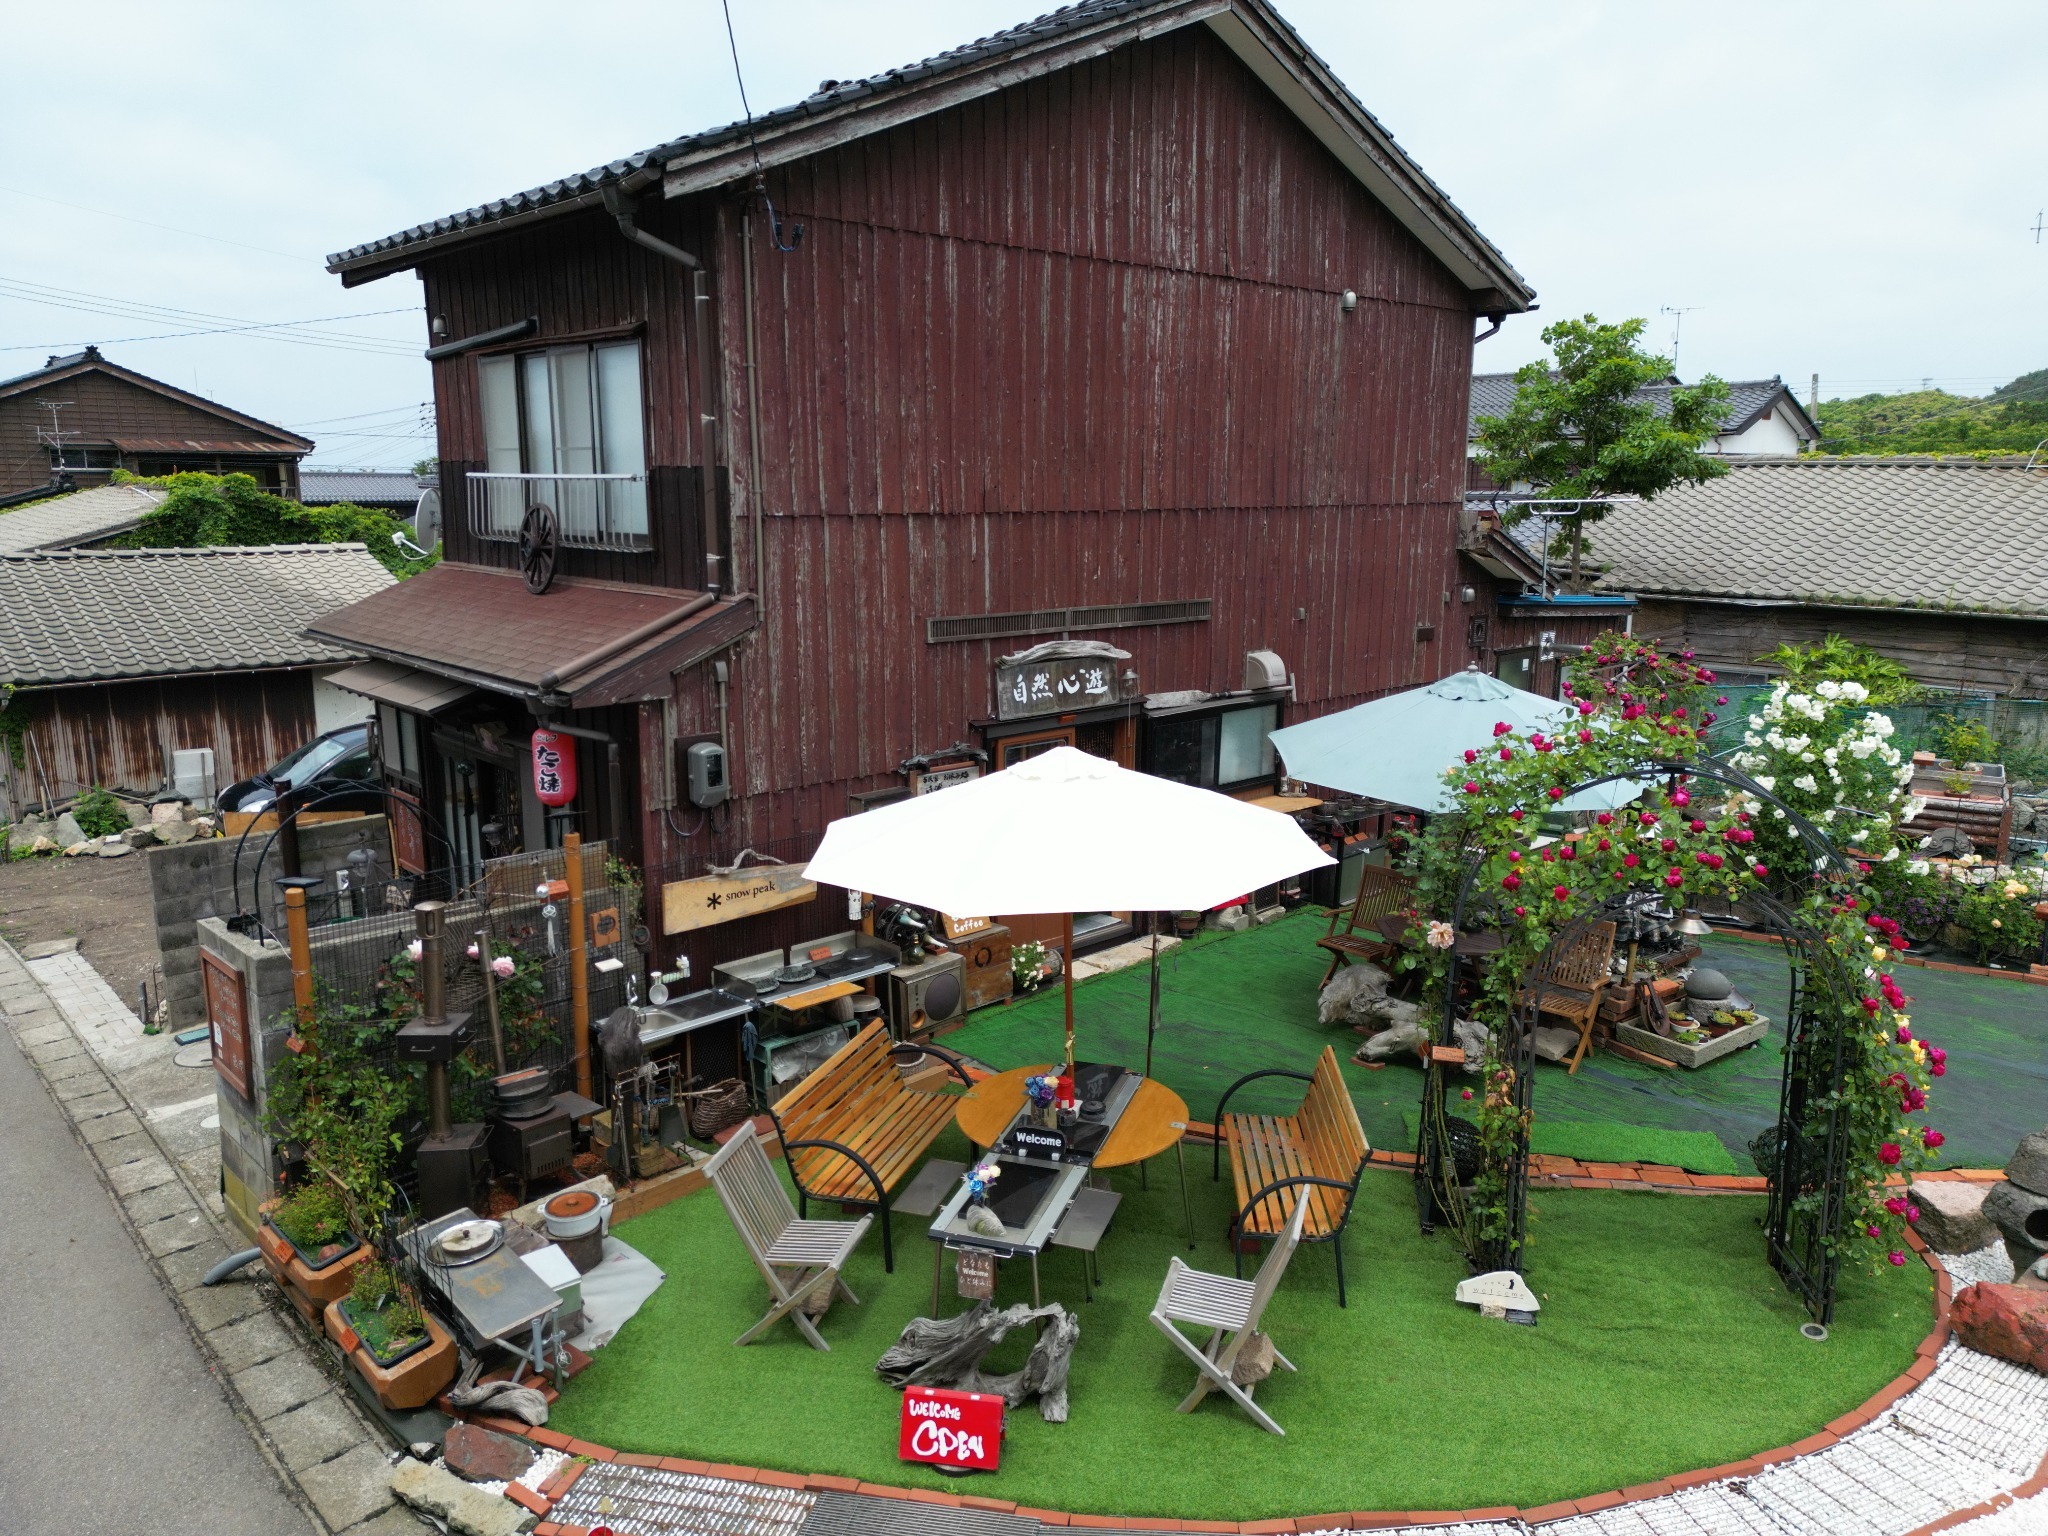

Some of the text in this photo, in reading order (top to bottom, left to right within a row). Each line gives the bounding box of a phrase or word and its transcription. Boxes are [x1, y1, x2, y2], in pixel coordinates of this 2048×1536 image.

[1013, 667, 1108, 704] 自然心遊
[537, 745, 561, 793] たこ焼
[725, 881, 776, 901] snow peak
[953, 919, 984, 933] Coffee
[1016, 1131, 1062, 1147] Welcome
[962, 1267, 989, 1278] Welcome
